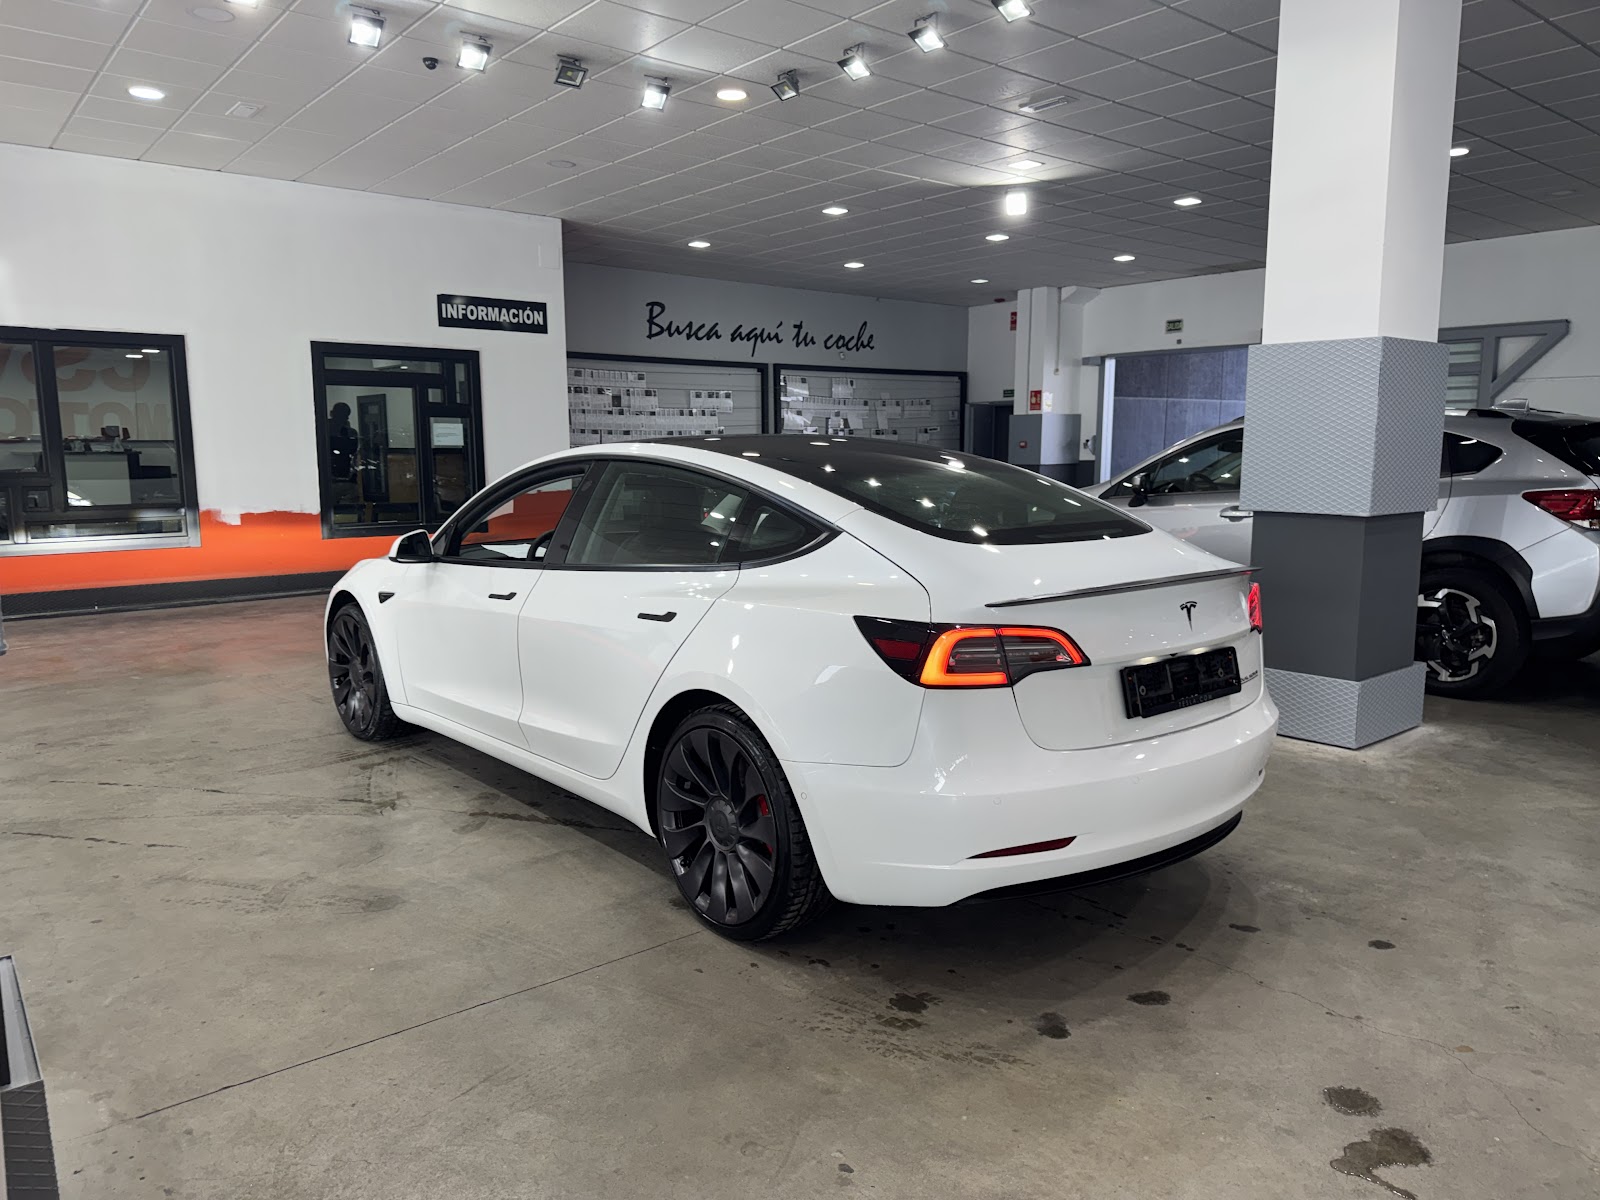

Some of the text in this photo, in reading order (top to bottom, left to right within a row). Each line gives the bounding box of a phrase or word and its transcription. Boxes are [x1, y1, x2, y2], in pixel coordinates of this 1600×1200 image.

[441, 303, 544, 325] INFORMACIÓN
[645, 301, 875, 357] Busca aquí tu coche
